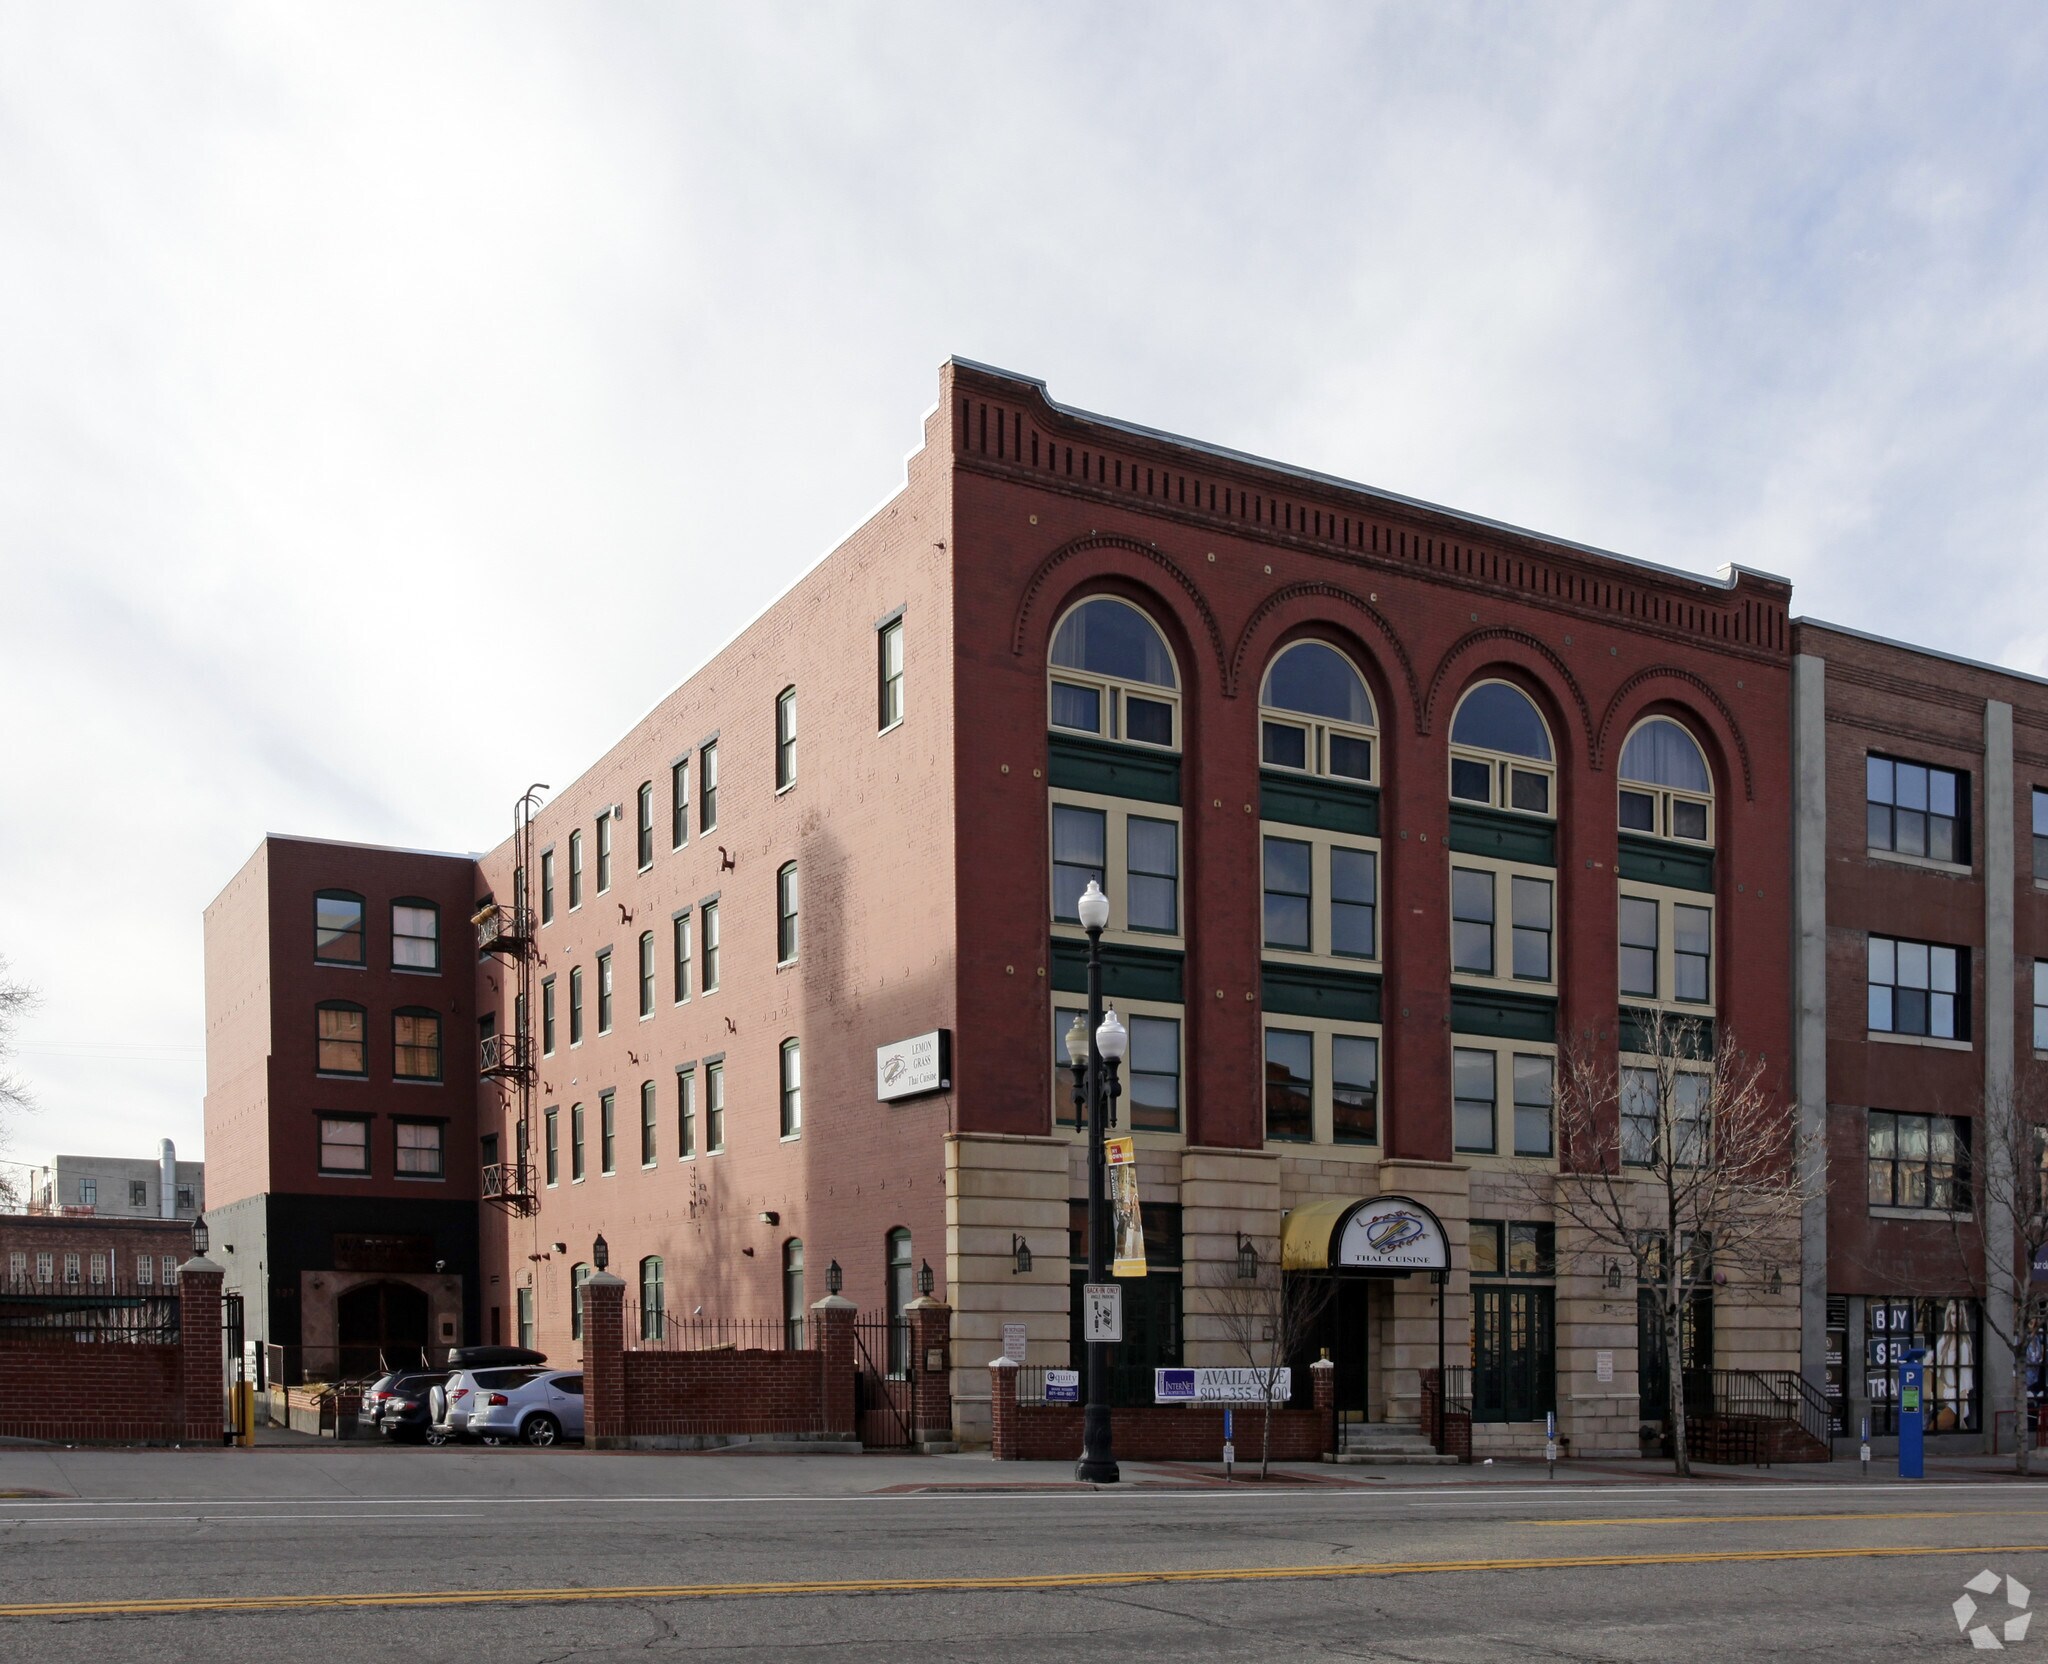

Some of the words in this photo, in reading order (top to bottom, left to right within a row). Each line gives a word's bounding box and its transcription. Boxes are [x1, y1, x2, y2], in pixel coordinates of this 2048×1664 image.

[912, 1040, 932, 1055] LEMON
[913, 1055, 931, 1069] GRASS
[908, 1075, 919, 1086] Thai
[920, 1072, 937, 1083] Cuisine
[1387, 1255, 1431, 1264] CUISINE
[1876, 1310, 1907, 1330] BUY
[1876, 1343, 1919, 1365] SEL
[1047, 1372, 1077, 1383] equity
[1201, 1369, 1287, 1385] AVAILABE
[1906, 1371, 1915, 1383] P
[1200, 1386, 1288, 1401] 801-355-000
